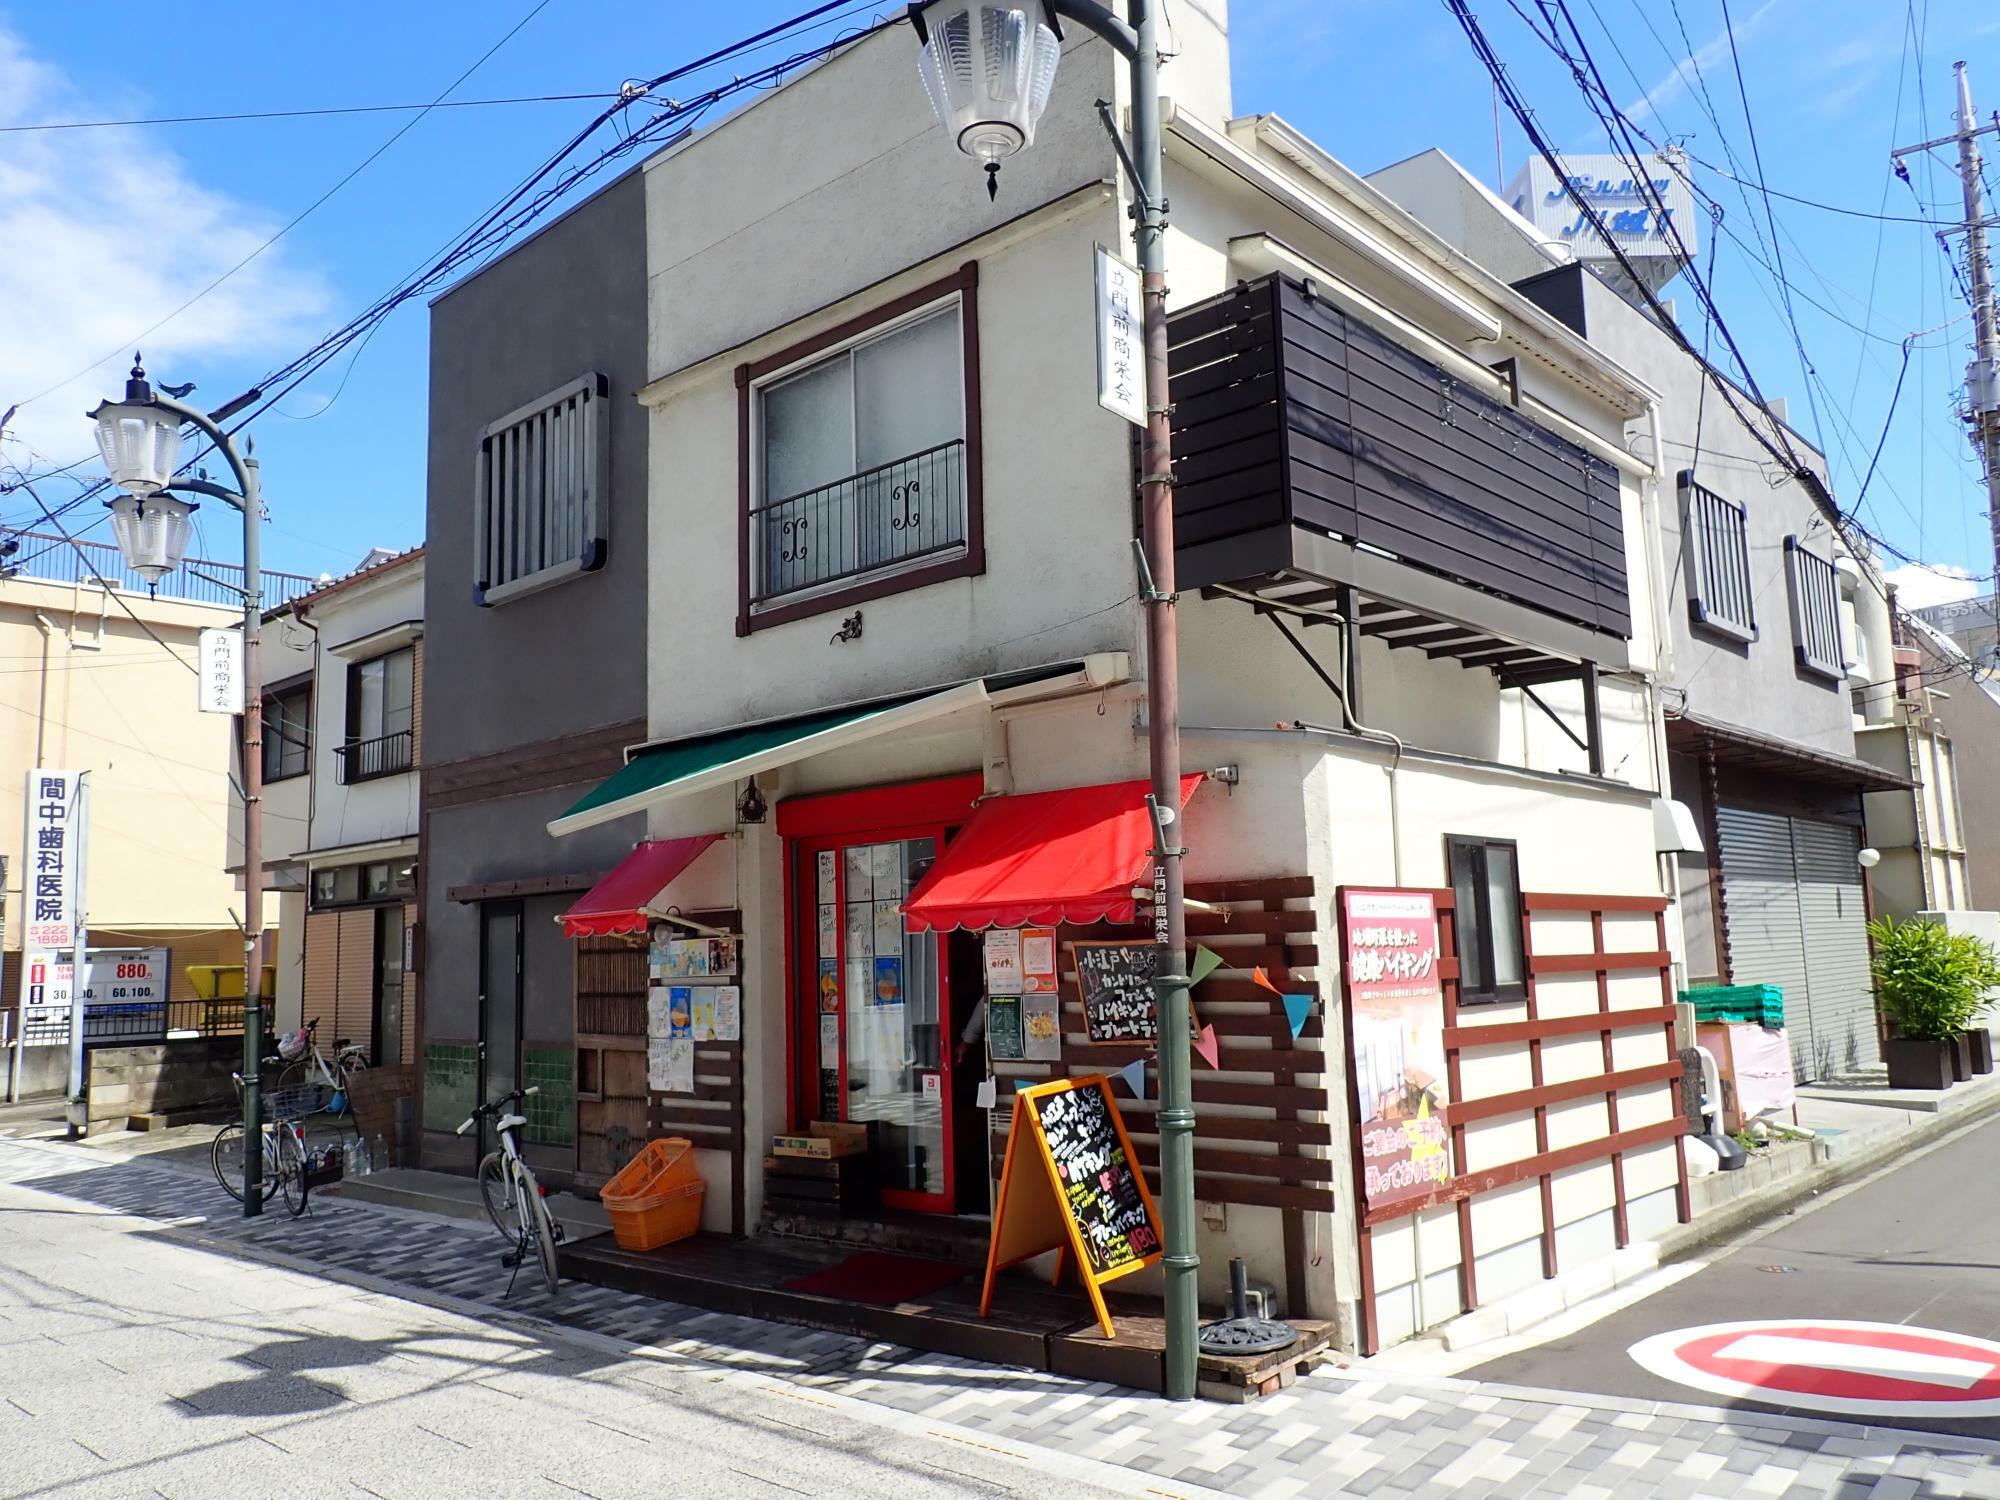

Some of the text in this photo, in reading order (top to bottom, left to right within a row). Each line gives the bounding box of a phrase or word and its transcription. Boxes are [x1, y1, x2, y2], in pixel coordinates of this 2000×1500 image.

[1111, 270, 1134, 405] 立門前商栄会
[213, 635, 231, 707] 立門前商栄会
[35, 777, 66, 922] 間中歯科医院
[1154, 865, 1169, 944] 立門前商栄会
[1351, 947, 1434, 984] 健康バイキング
